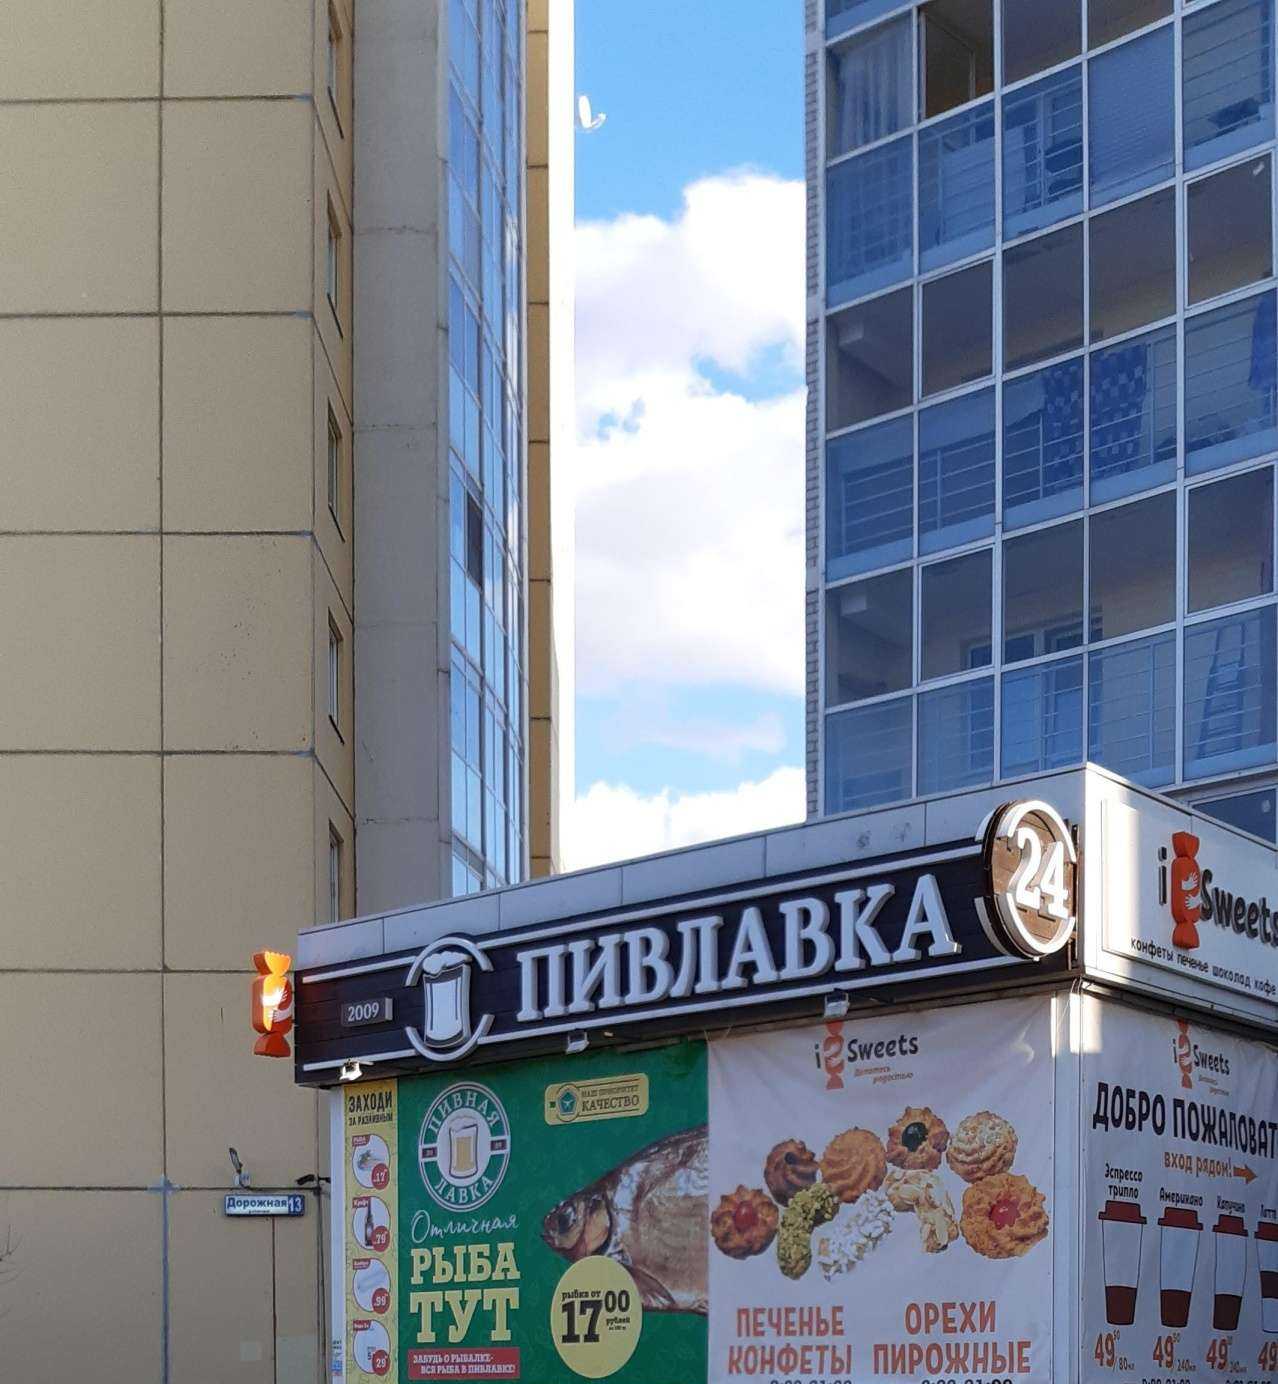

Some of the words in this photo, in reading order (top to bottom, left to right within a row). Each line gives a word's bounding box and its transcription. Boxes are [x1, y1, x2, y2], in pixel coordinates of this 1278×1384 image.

[1011, 827, 1072, 921] 24
[516, 873, 963, 1022] ПИВЛАВКА
[1131, 938, 1173, 961] конфеты
[1177, 954, 1209, 974] печенье
[1213, 966, 1251, 989] шоколад
[1254, 977, 1277, 996] кофе
[347, 1002, 379, 1022] 2009
[848, 1034, 919, 1063] Sweets
[1194, 1044, 1230, 1076] Sweets
[348, 1091, 393, 1113] ЗАХОДИ
[428, 1091, 500, 1133] ПИВНАЯ
[582, 1095, 640, 1112] КАЧЕСТВО
[1092, 1081, 1166, 1136] ДОБРО
[1105, 1163, 1143, 1183] Эспрессо
[1164, 1151, 1192, 1174] вход
[1196, 1156, 1233, 1178] рядом!
[227, 1197, 288, 1209] Дорожная
[289, 1197, 302, 1212] 13
[434, 1176, 494, 1203] ЛАВКА
[1108, 1184, 1139, 1199] трипло
[1159, 1187, 1203, 1207] Американо
[411, 1209, 520, 1244] Отличная
[410, 1242, 521, 1284] РЫБА
[409, 1287, 520, 1343] ТУТ
[561, 1300, 603, 1343] 17
[605, 1290, 630, 1313] 00
[736, 1306, 845, 1337] ПЕЧЕНЬЕ
[904, 1301, 996, 1335] ОРЕХИ
[728, 1342, 852, 1374] КОНФЕТЫ
[873, 1341, 1032, 1375] ПИРОЖНЫЕ
[1095, 1333, 1115, 1367] 49
[1153, 1336, 1174, 1368] 49
[1206, 1339, 1228, 1370] 49
